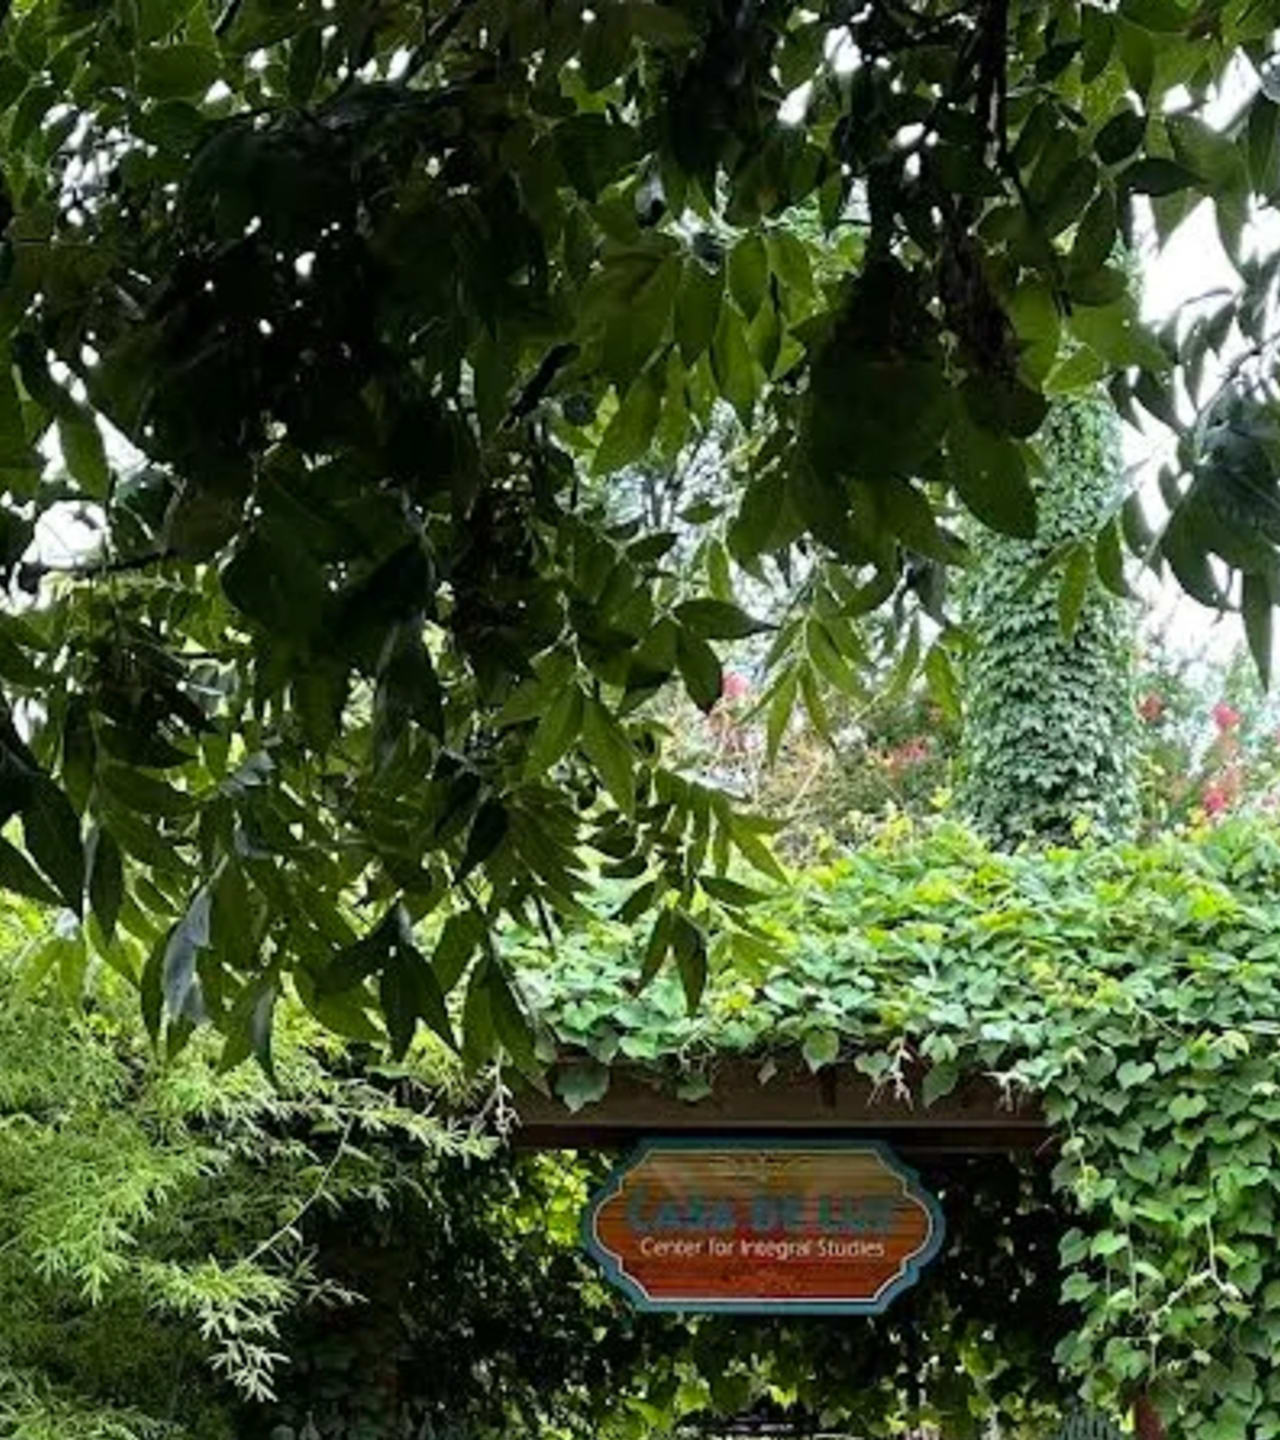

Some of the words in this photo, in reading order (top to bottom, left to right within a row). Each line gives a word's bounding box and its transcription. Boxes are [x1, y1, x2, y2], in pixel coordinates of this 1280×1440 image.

[640, 1236, 702, 1258] Center
[708, 1236, 734, 1257] for
[740, 1236, 812, 1261] Integral
[818, 1236, 886, 1258] Studies
